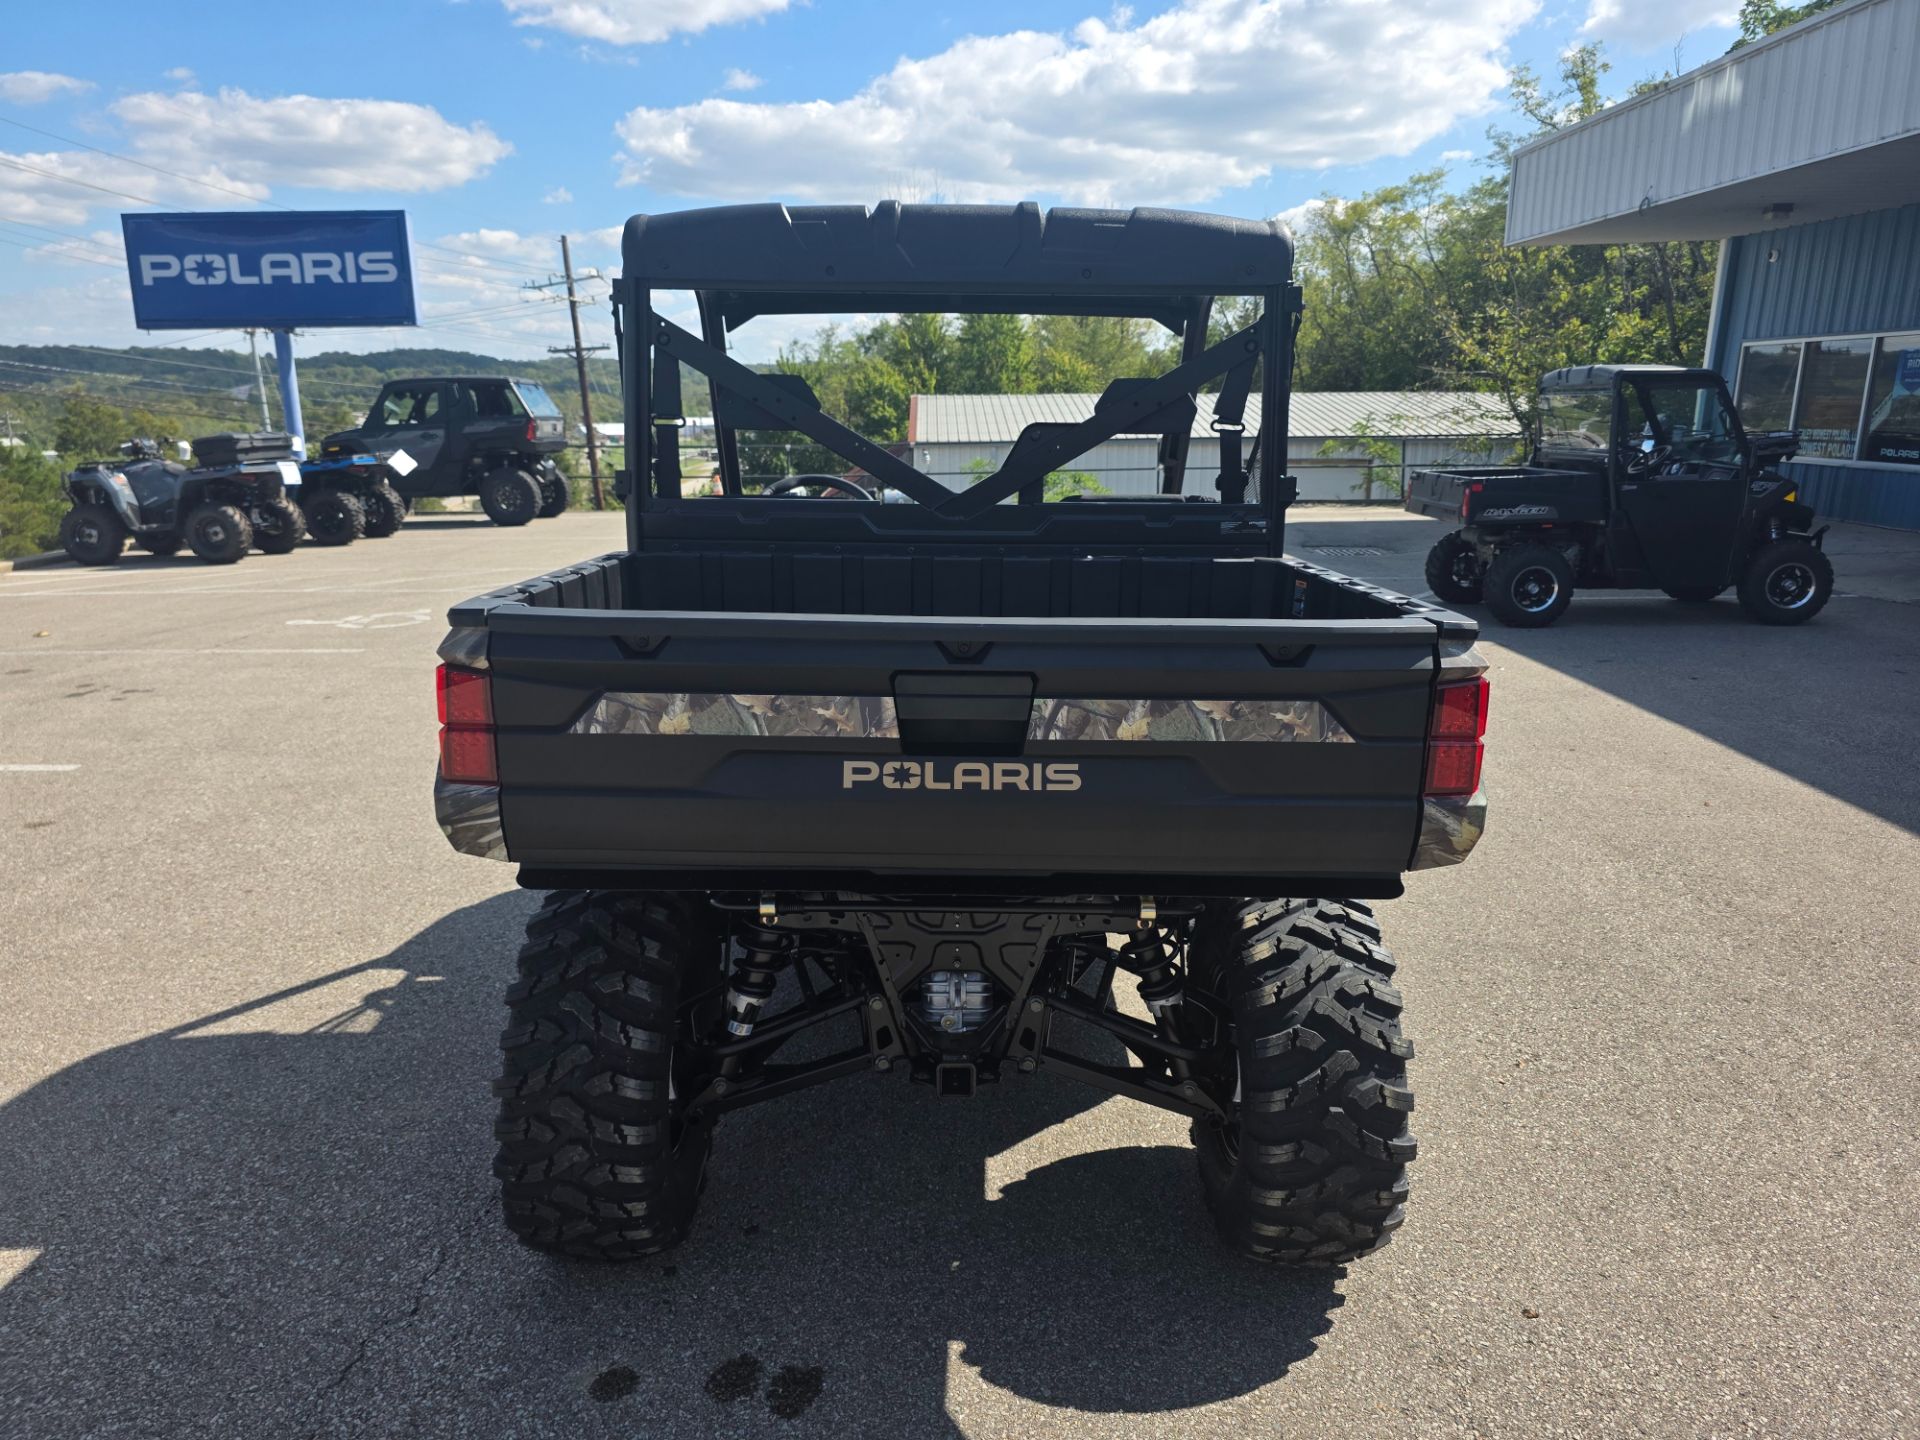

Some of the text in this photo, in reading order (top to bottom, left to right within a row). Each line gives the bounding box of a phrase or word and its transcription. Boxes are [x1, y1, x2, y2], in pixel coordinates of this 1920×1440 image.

[139, 251, 398, 286] POLARIS
[1879, 447, 1920, 459] POLARIS
[843, 760, 1082, 791] POLARIS
